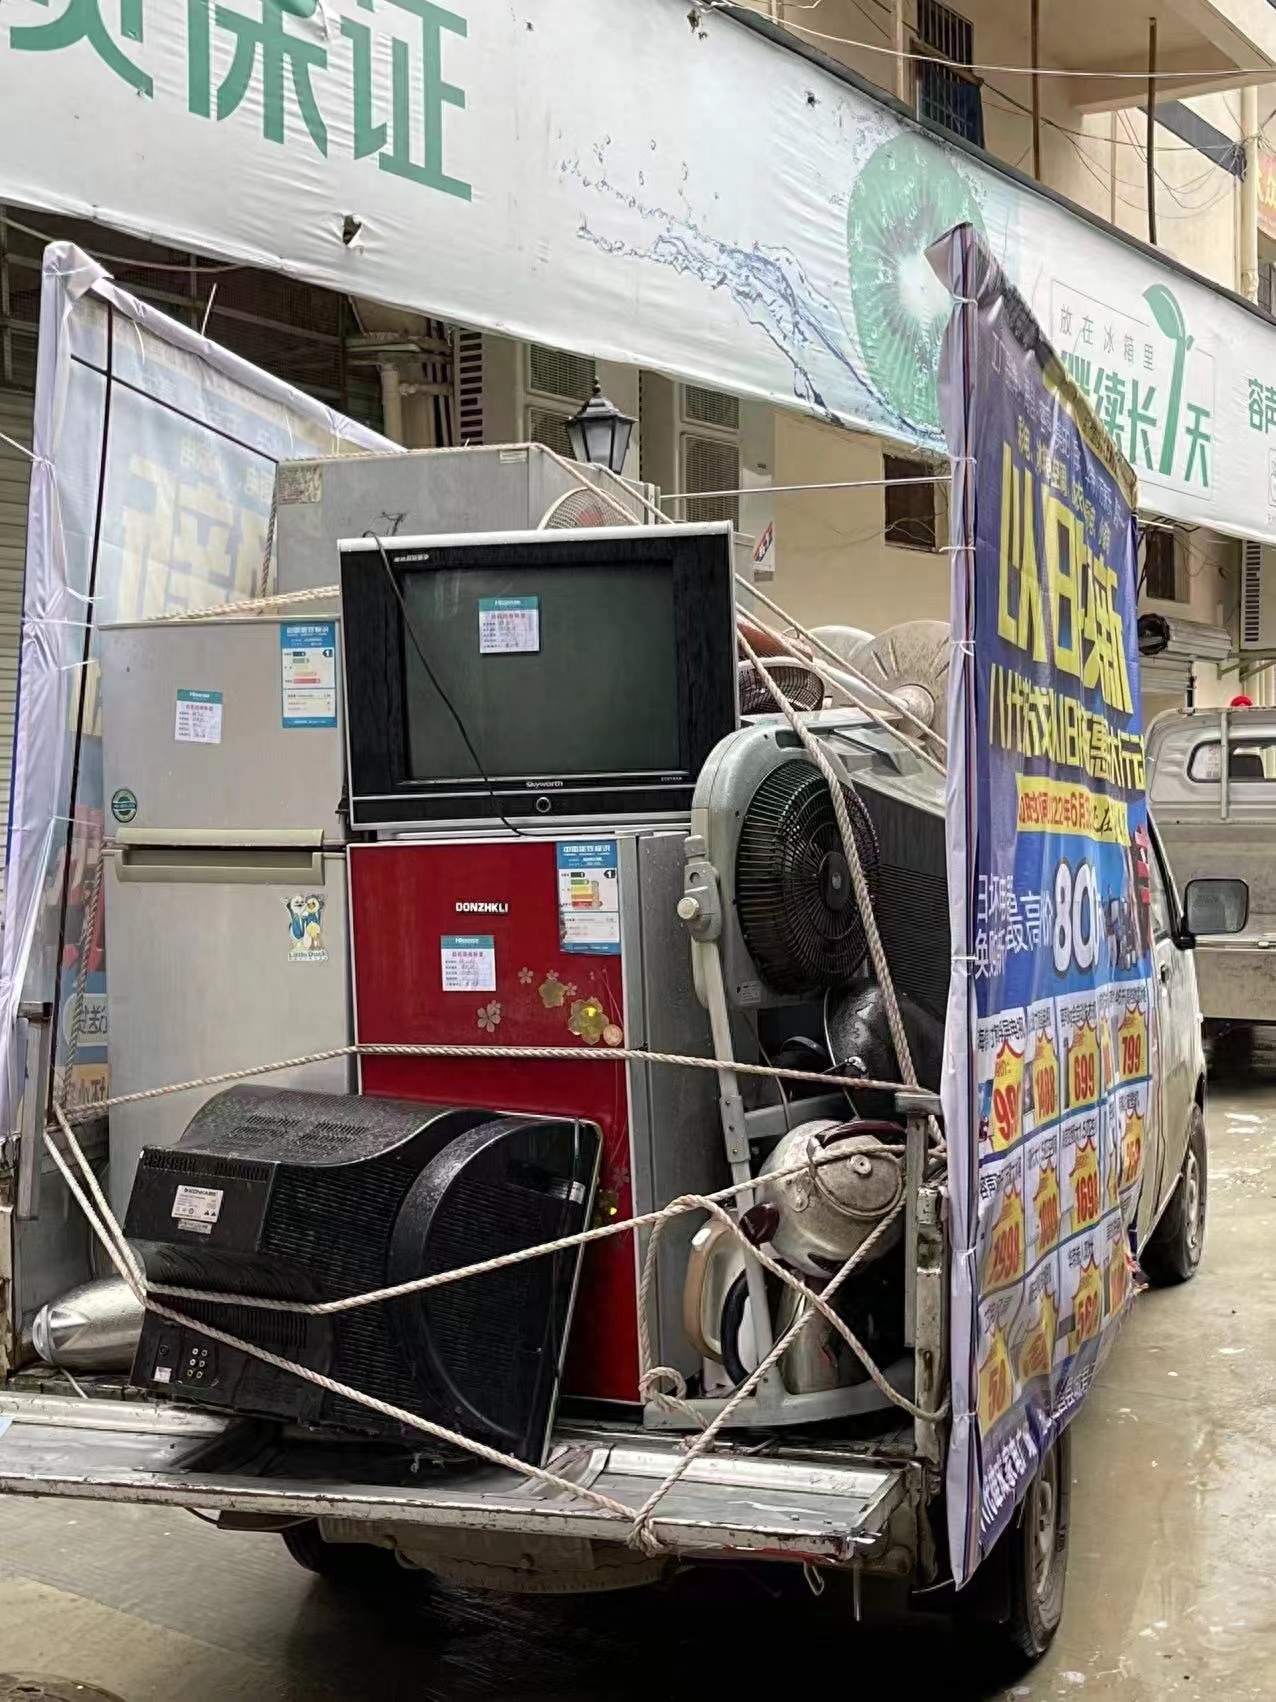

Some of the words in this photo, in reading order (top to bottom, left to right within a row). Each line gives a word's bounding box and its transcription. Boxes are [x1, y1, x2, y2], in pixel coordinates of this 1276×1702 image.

[1059, 303, 1154, 371] 放在冰箱里
[526, 781, 564, 789] Skyworth
[1073, 1052, 1095, 1102] 699
[1121, 1035, 1141, 1076] 799
